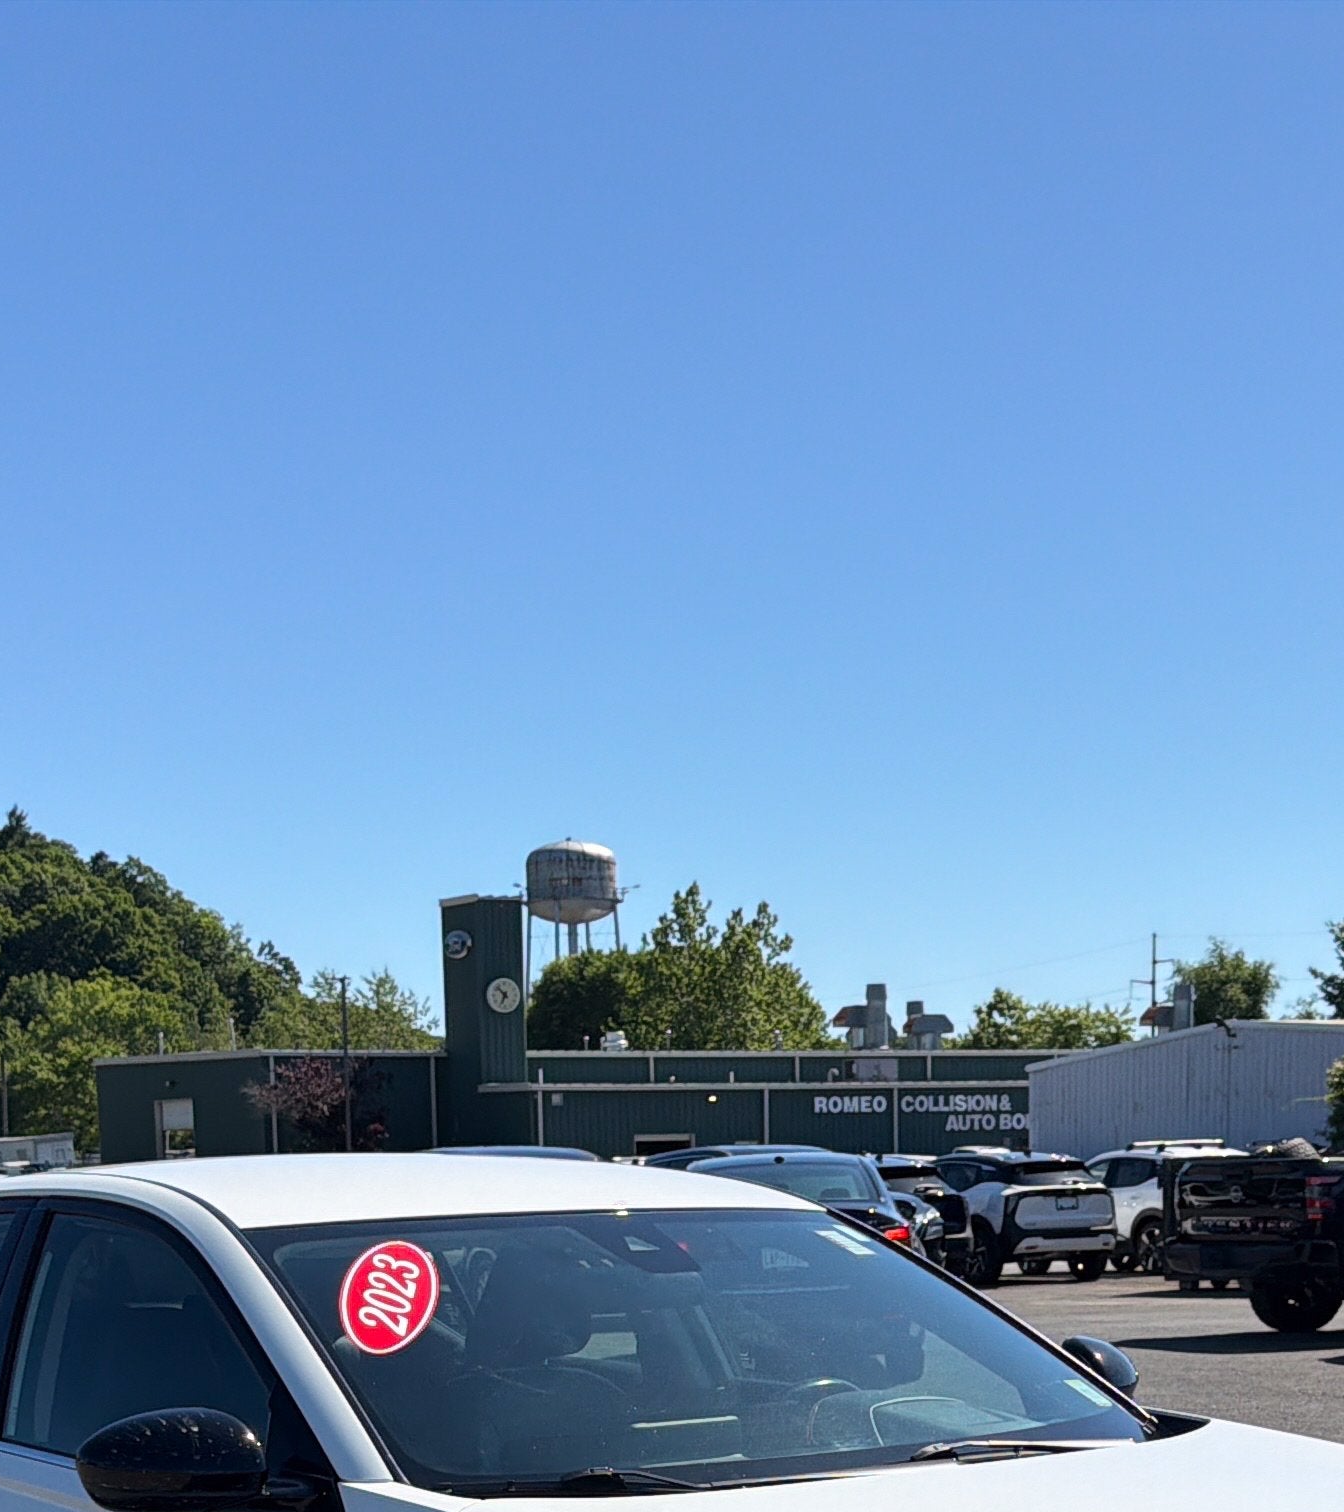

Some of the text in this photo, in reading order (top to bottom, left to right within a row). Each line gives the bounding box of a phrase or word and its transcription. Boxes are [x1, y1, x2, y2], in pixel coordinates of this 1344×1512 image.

[814, 1096, 887, 1113] ROMEO
[901, 1094, 998, 1112] COLLISION
[945, 1113, 996, 1132] AUTO
[358, 1253, 420, 1337] 2023
